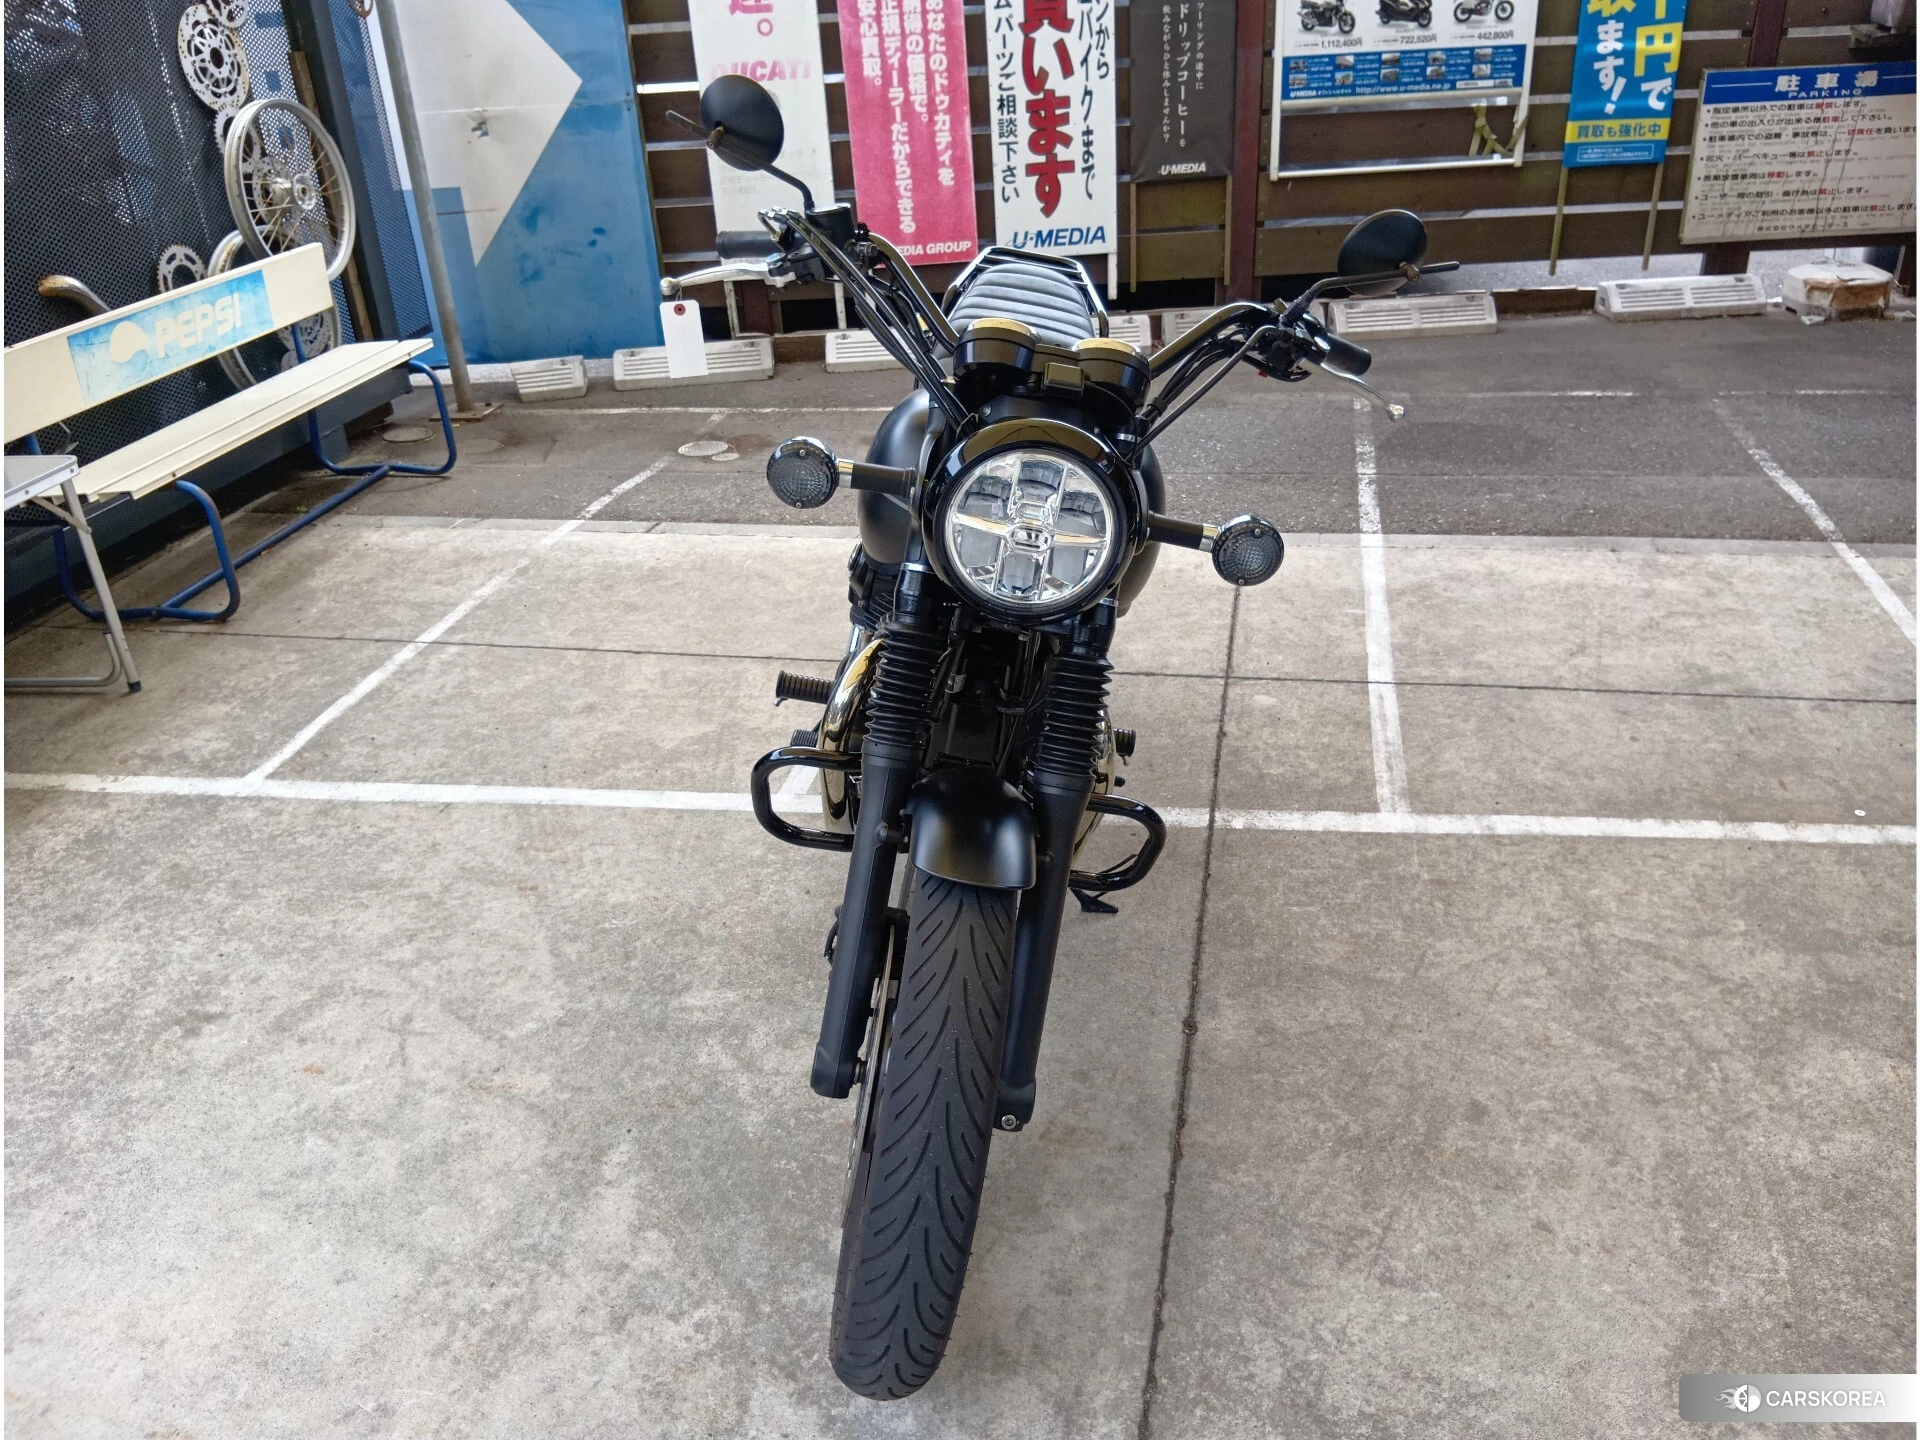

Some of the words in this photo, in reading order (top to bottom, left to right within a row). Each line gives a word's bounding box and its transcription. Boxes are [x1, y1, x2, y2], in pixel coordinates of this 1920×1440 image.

[1177, 3, 1191, 147] ドリップコーヒーを
[1788, 88, 1863, 99] PARKING
[1577, 122, 1662, 139] 買取も強化中
[926, 241, 972, 254] GROUP
[156, 292, 242, 358] PEPSI
